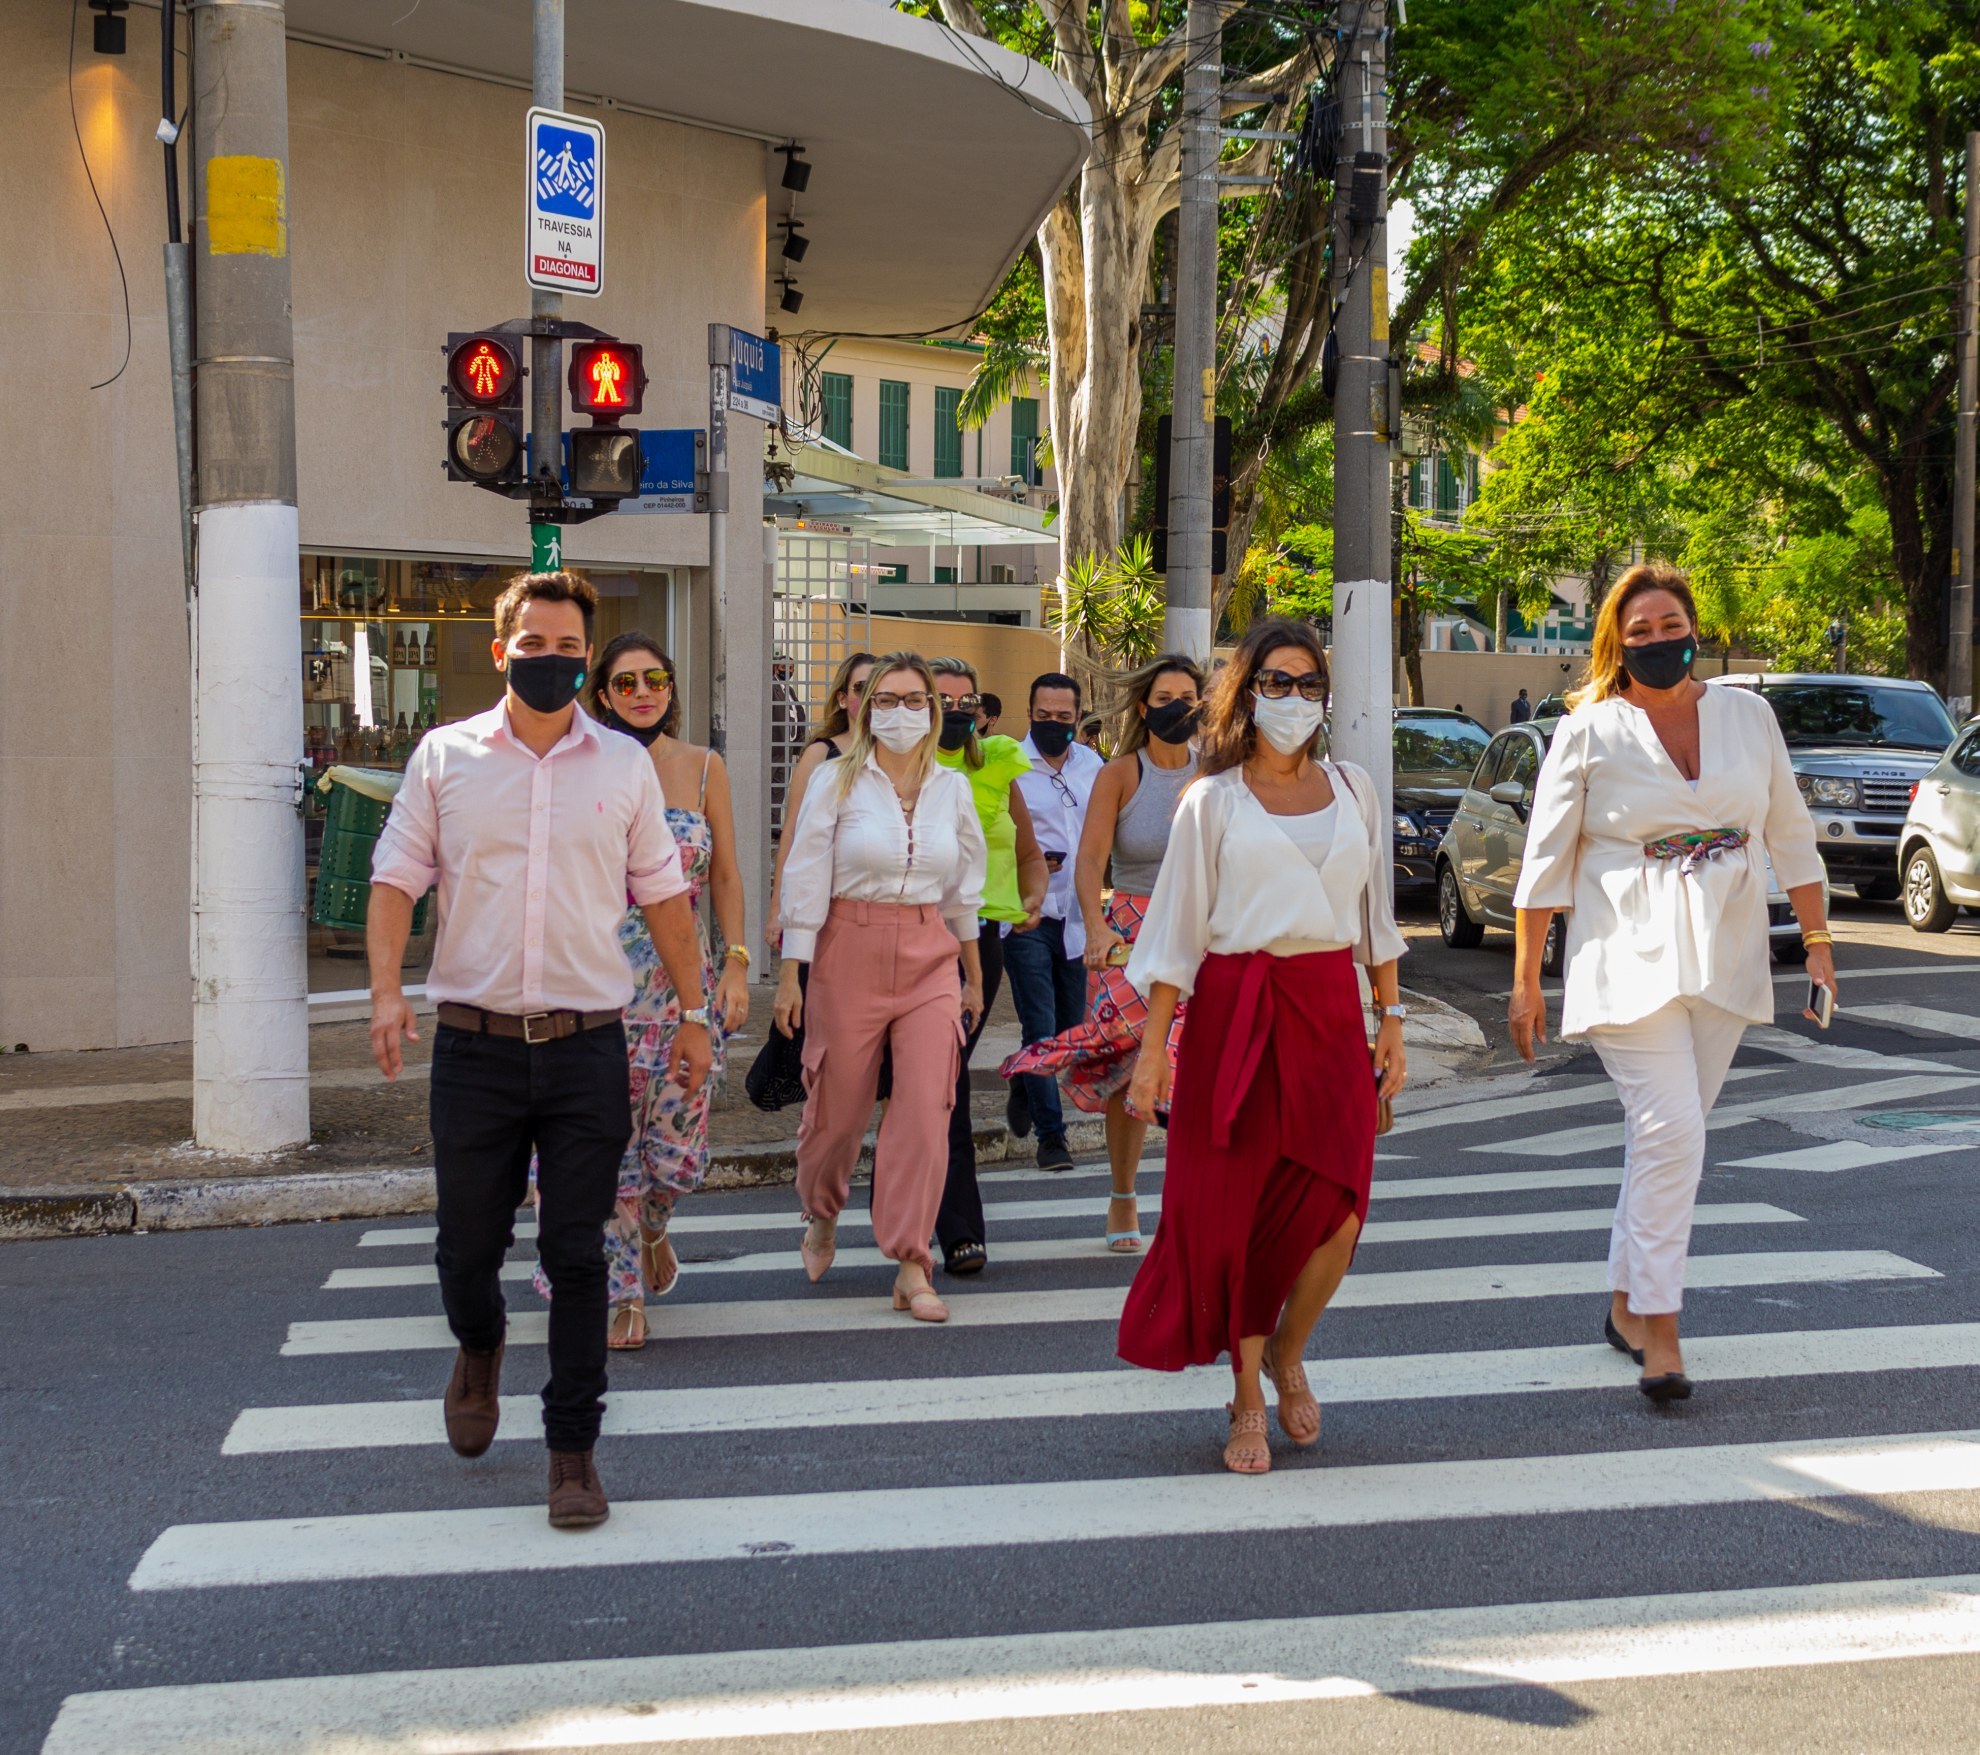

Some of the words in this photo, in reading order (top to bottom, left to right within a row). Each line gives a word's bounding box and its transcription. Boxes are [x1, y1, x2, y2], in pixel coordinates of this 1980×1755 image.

[538, 218, 592, 238] TRAVESSIA
[558, 240, 572, 253] NA
[539, 259, 591, 278] DIAGONAL
[732, 333, 764, 376] Juquiá
[657, 480, 669, 489] da
[671, 479, 694, 489] Silva
